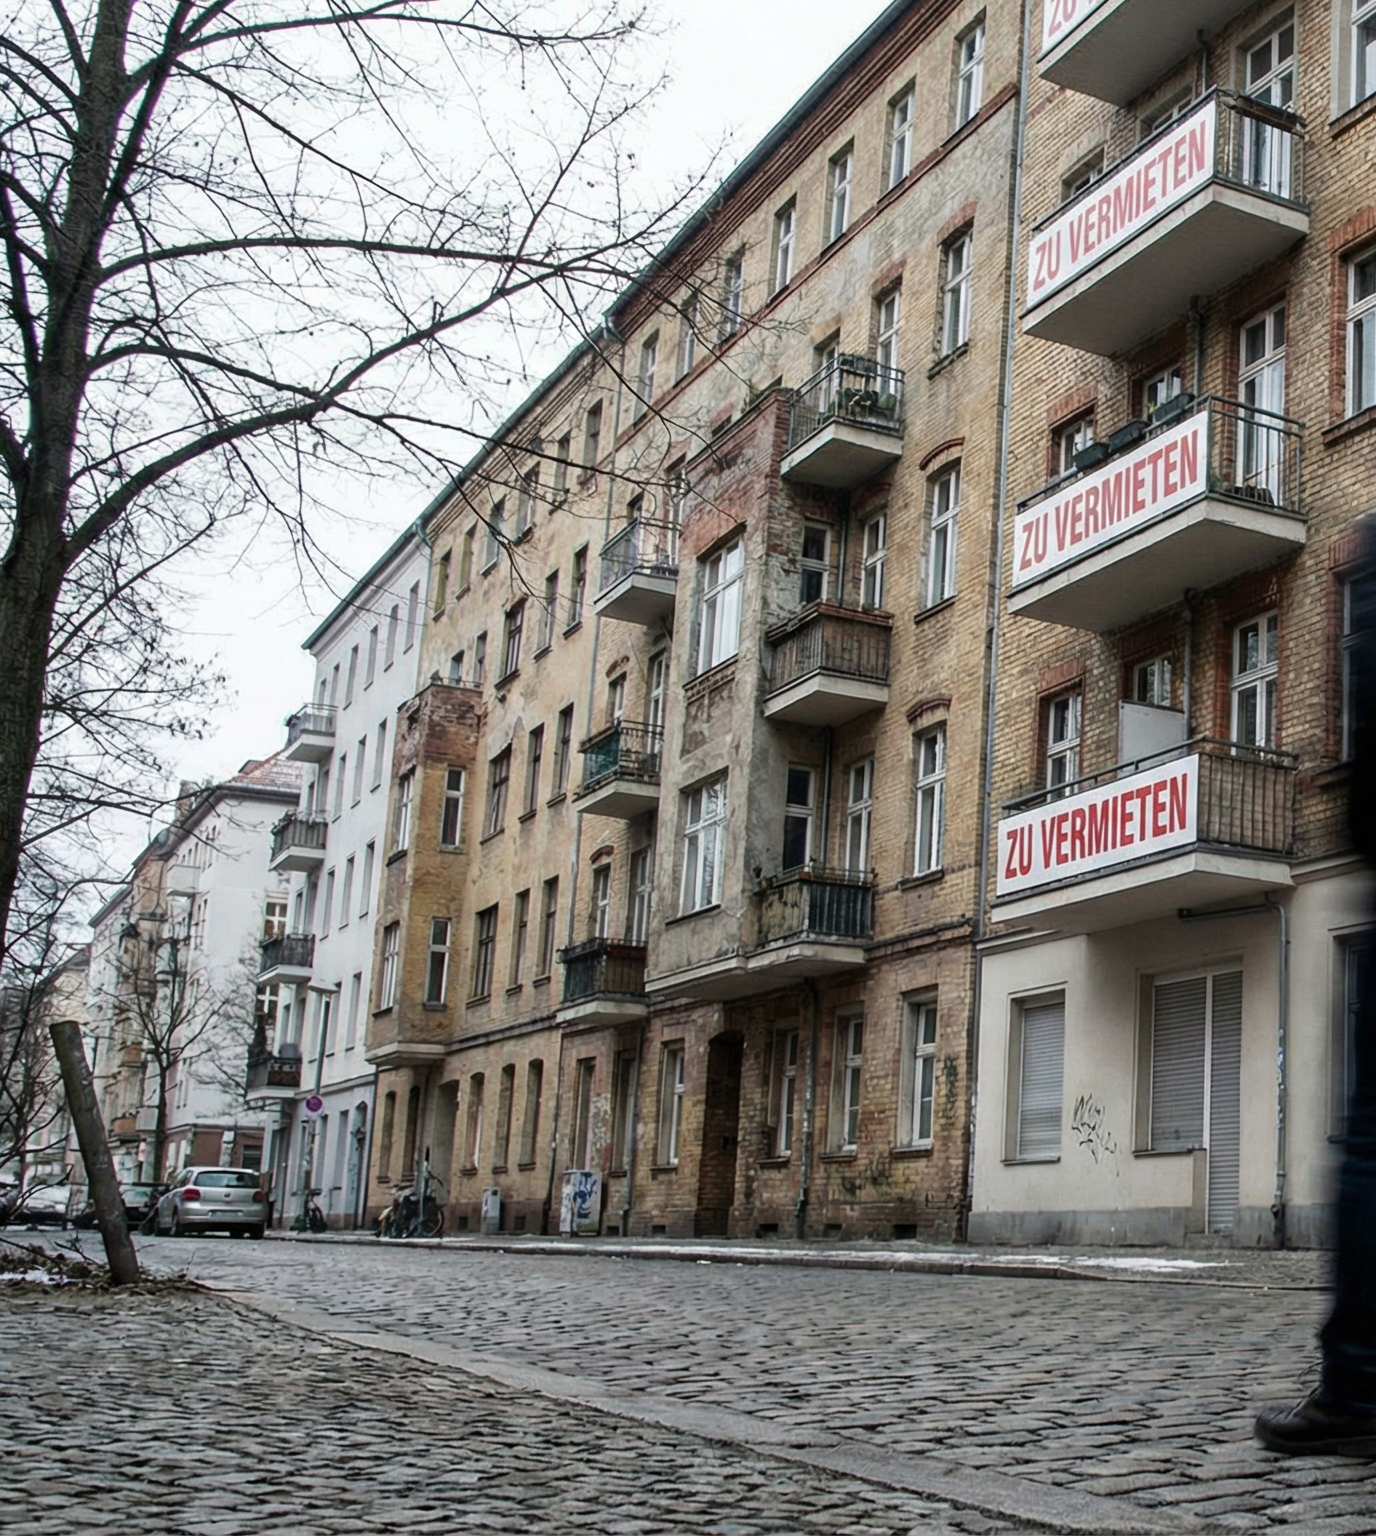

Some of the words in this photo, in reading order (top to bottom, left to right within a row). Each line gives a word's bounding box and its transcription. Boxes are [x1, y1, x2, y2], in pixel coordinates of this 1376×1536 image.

[1032, 230, 1061, 291] ZU
[1068, 119, 1206, 264] VERMIETEN
[1019, 514, 1047, 571] ZU
[1054, 429, 1198, 552] VERMIETEN
[1004, 826, 1033, 879] ZU
[1041, 773, 1188, 869] VERMIETEN
